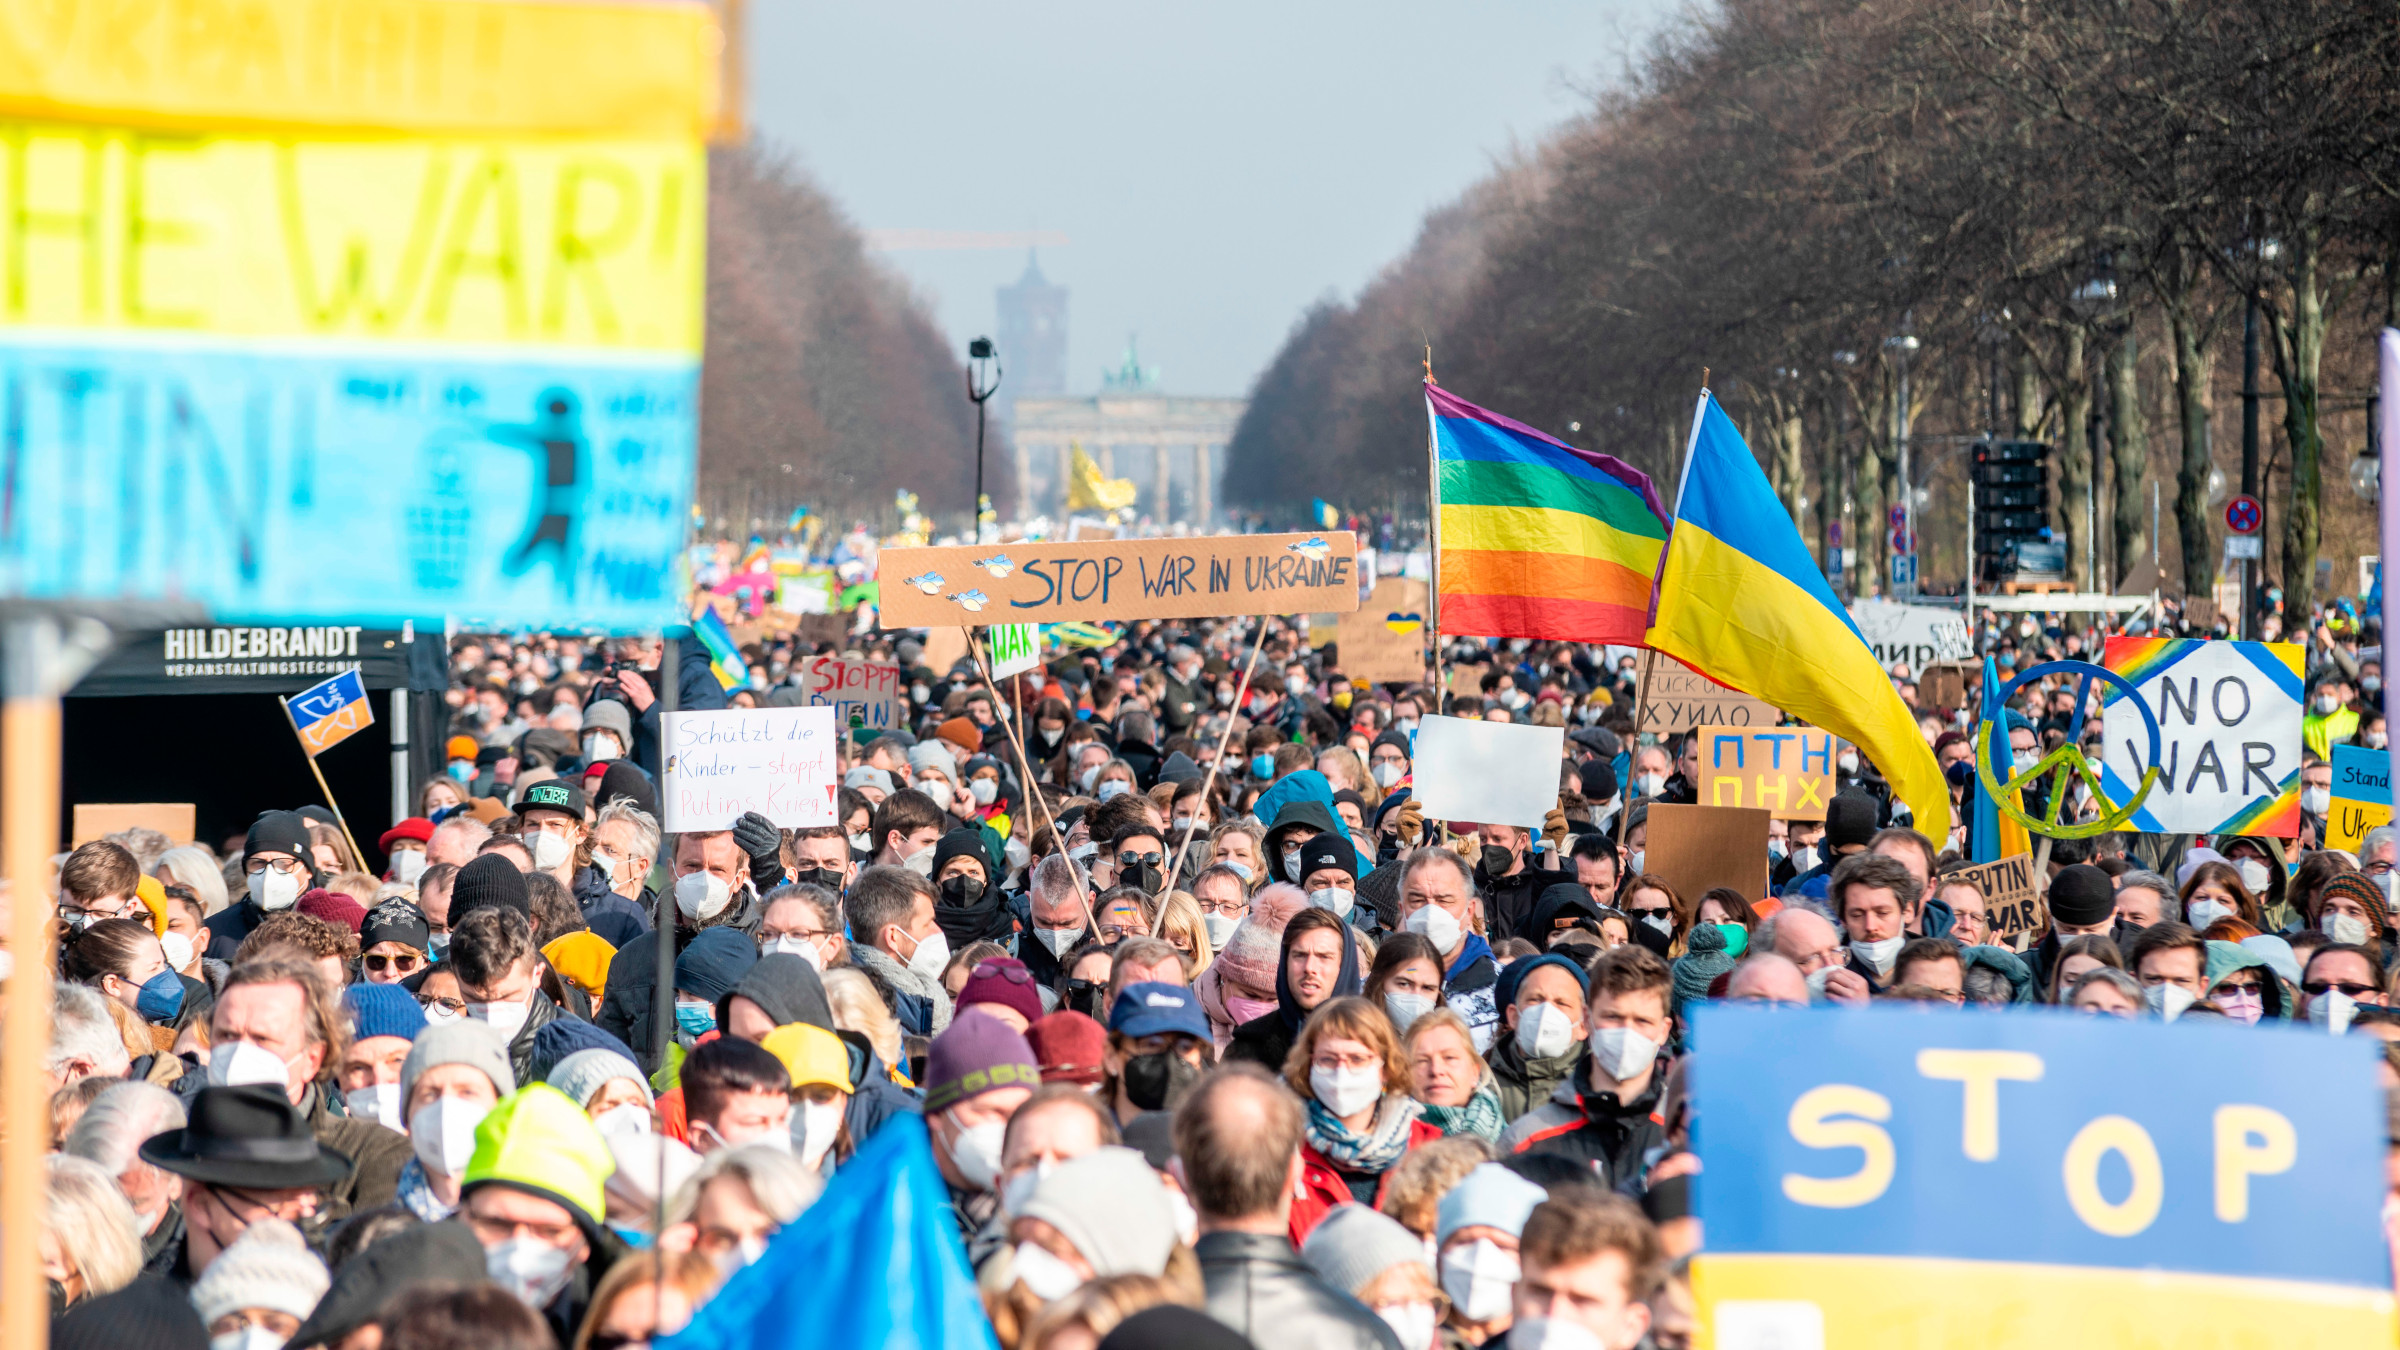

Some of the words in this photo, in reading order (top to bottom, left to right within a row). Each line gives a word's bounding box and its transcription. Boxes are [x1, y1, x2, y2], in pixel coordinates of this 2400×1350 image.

[1010, 556, 1123, 608] STOP
[1140, 554, 1196, 599] WAR
[1245, 556, 1352, 592] UKRAINE
[164, 626, 362, 660] HILDEBRANDT
[165, 660, 363, 677] VERANSTALTUNGSTECHNIK
[811, 657, 900, 697] STOPPT
[2160, 676, 2250, 727] NO
[677, 718, 774, 747] Schützt
[787, 719, 814, 741] die
[679, 750, 737, 779] Kinder
[768, 750, 829, 784] stoppt
[1713, 734, 1831, 775] ПТН
[2126, 738, 2281, 797] WAR
[1713, 773, 1824, 811] ПНХ
[2342, 766, 2390, 790] Stand
[681, 790, 756, 818] Putins
[1986, 899, 2039, 933] WAR
[1783, 1048, 2298, 1237] STOP
